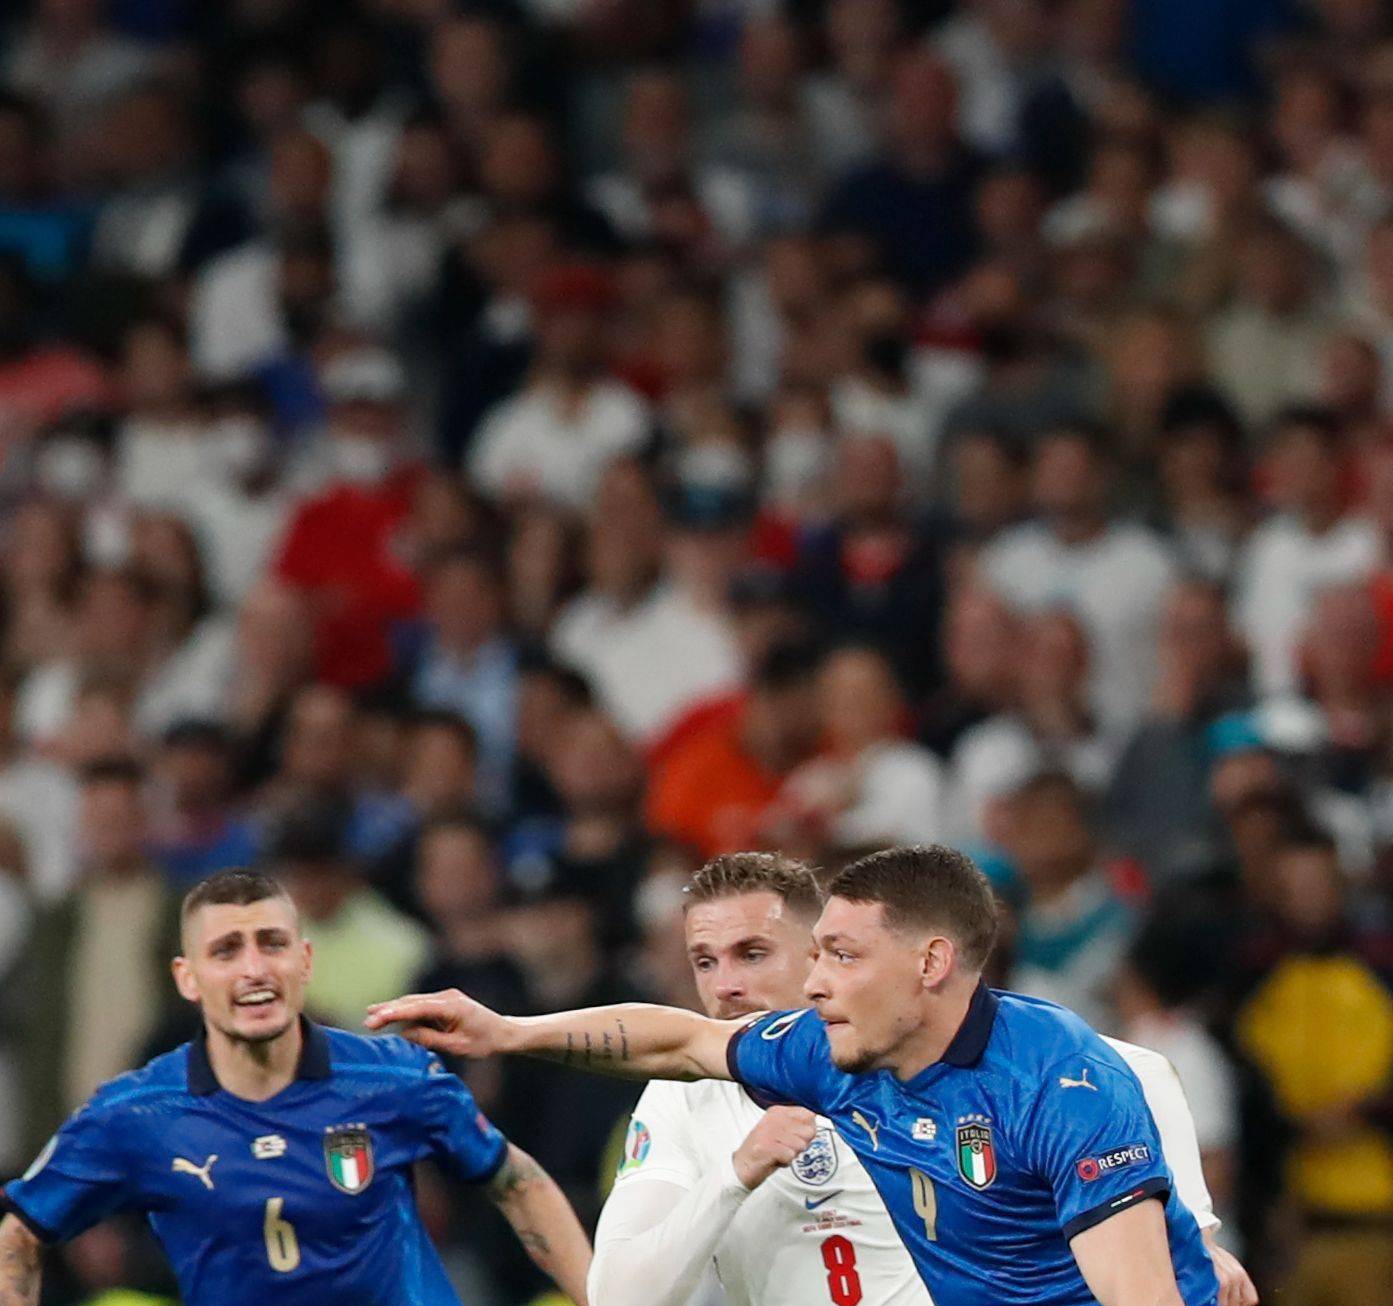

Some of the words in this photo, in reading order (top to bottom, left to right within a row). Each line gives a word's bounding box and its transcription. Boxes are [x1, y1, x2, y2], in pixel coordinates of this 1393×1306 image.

[1097, 1146, 1149, 1170] RESPECT
[263, 1196, 302, 1273] 6
[909, 1167, 938, 1242] 9
